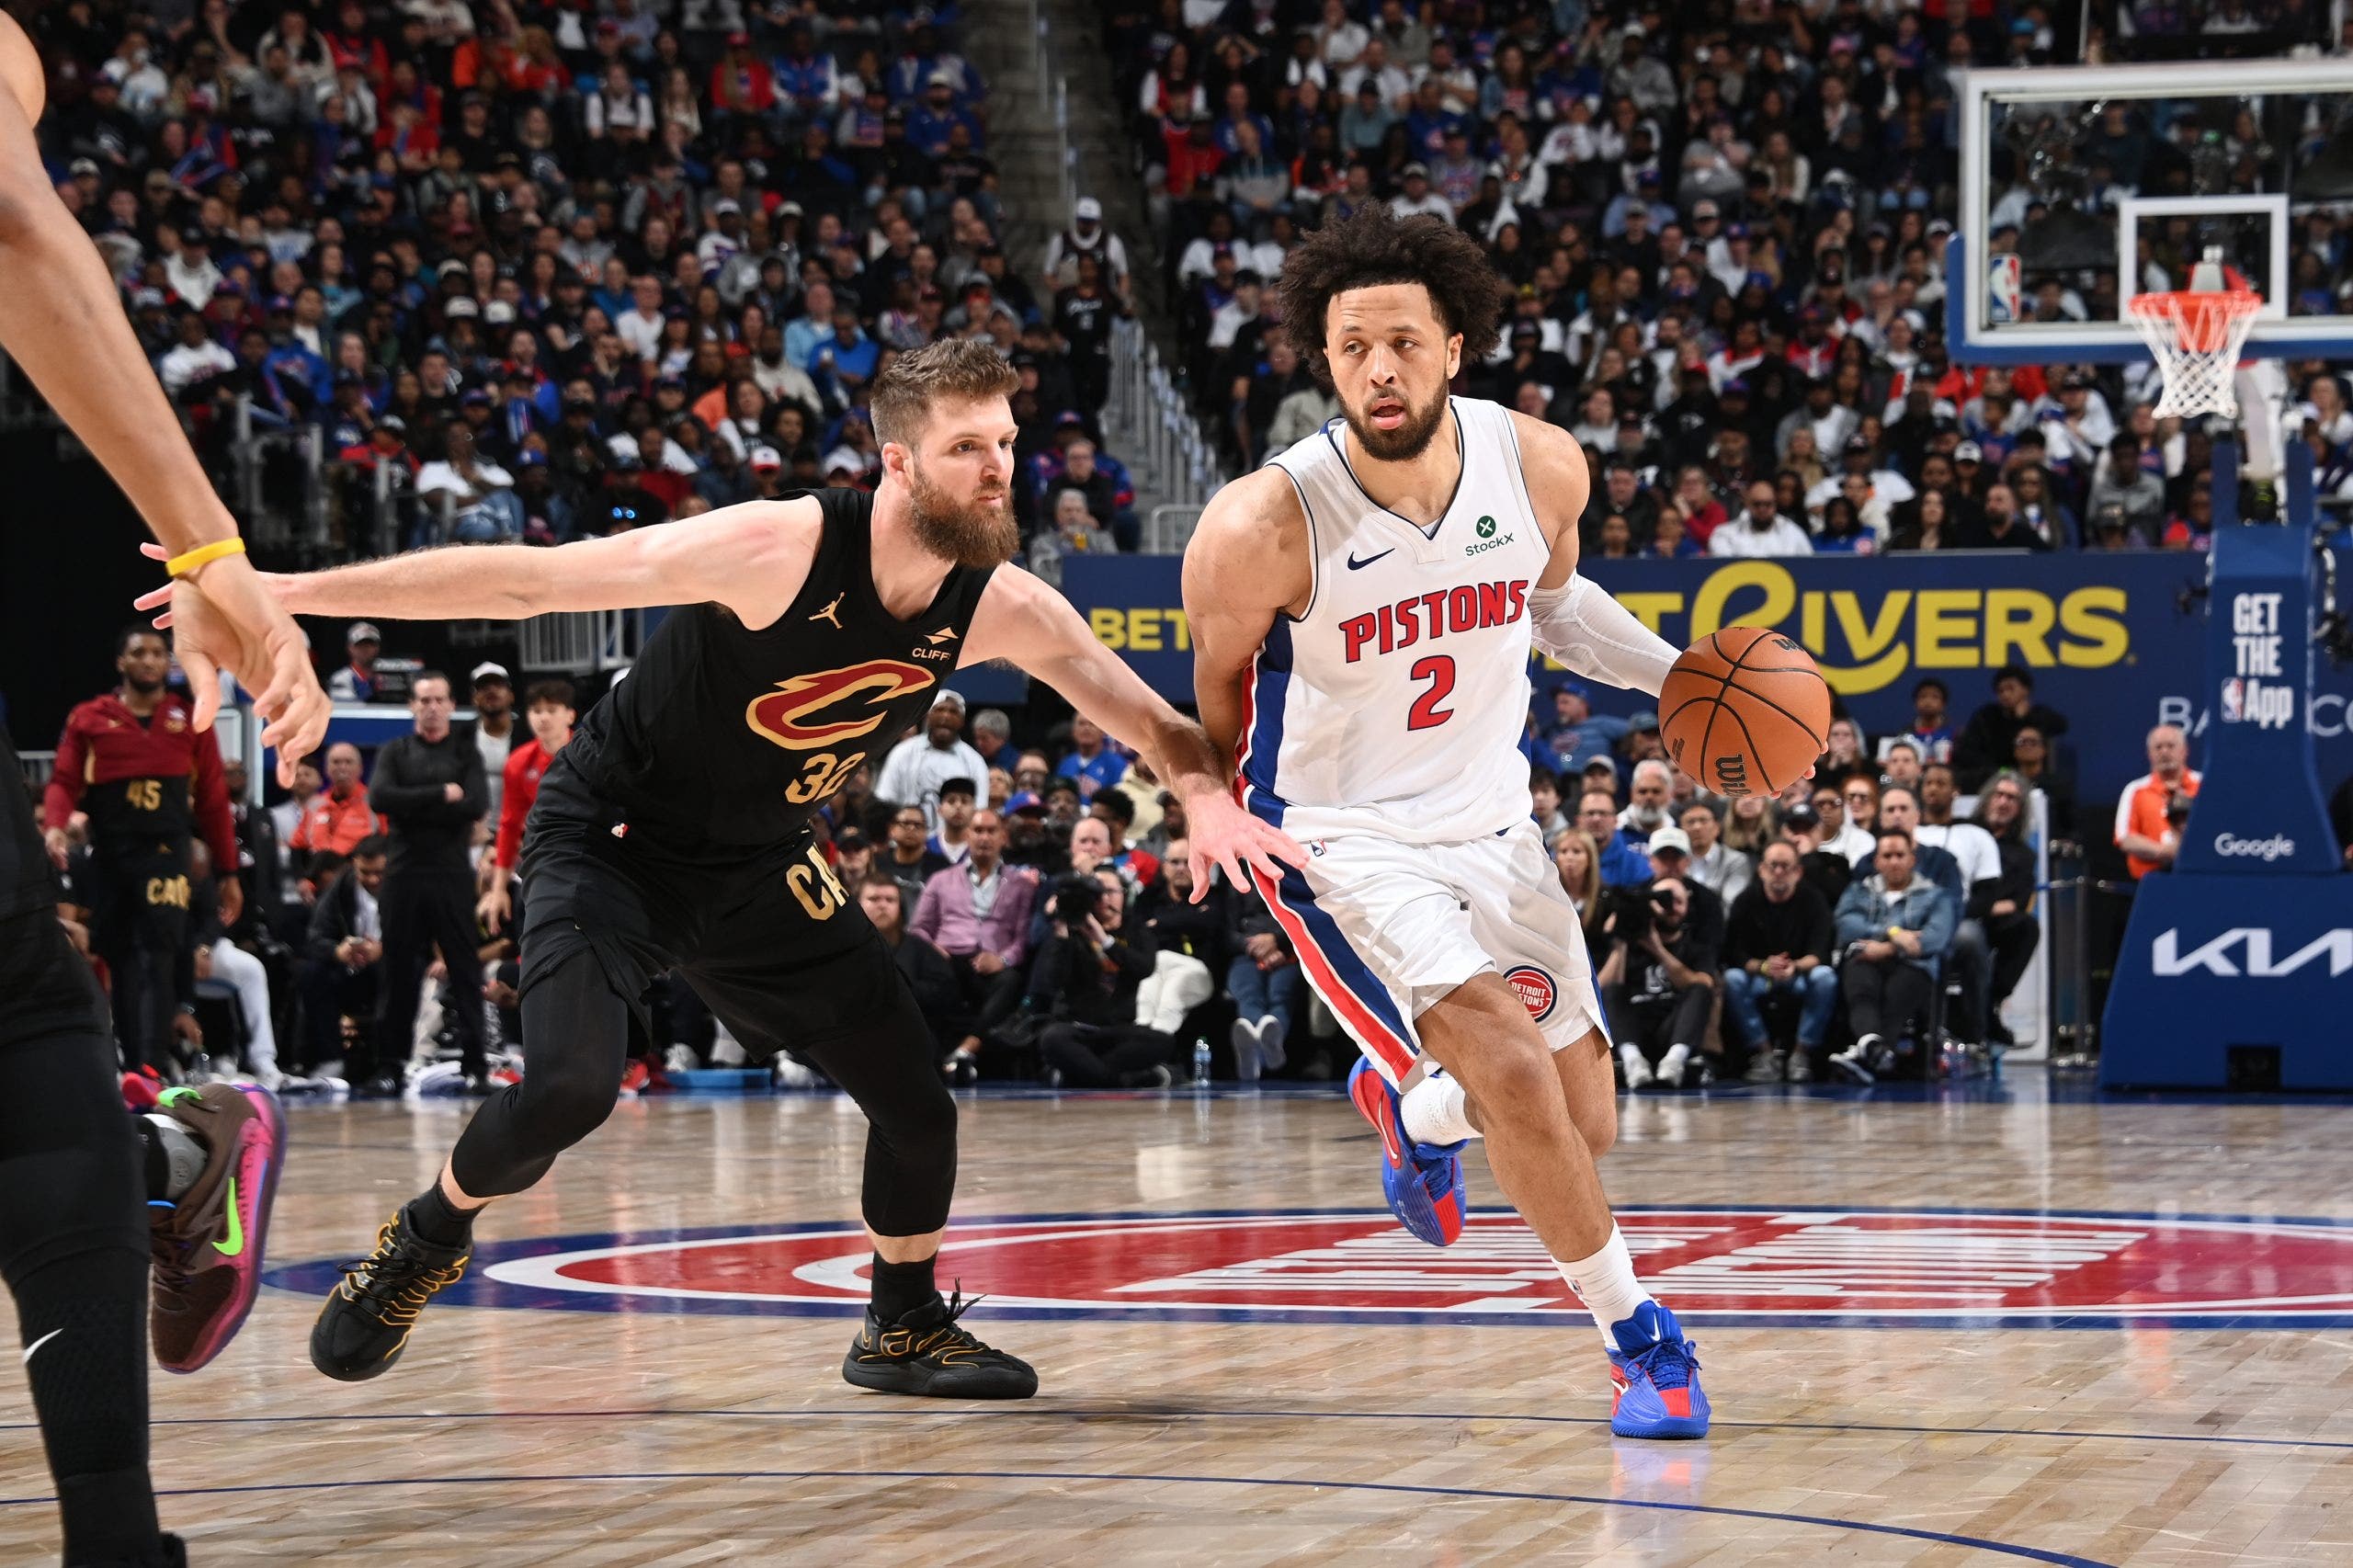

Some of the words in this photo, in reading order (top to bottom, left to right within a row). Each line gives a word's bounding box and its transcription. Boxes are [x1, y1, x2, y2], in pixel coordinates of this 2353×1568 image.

[1465, 532, 1515, 557] StockX
[1090, 608, 1190, 651] BET
[1338, 579, 1529, 664] PISTONS
[1530, 561, 2130, 695] TRIVERS
[2234, 593, 2281, 634] GET
[912, 647, 951, 661] CLIFF
[2233, 635, 2282, 676] THE
[1407, 654, 1456, 732] 2
[2244, 678, 2294, 729] App
[126, 779, 163, 811] 45
[785, 752, 866, 804] 32
[1714, 753, 1752, 798] Wil
[2214, 833, 2295, 862] Google
[2153, 927, 2353, 977] KIA
[1511, 982, 1547, 998] DETROIT
[1518, 994, 1545, 1007] STONS
